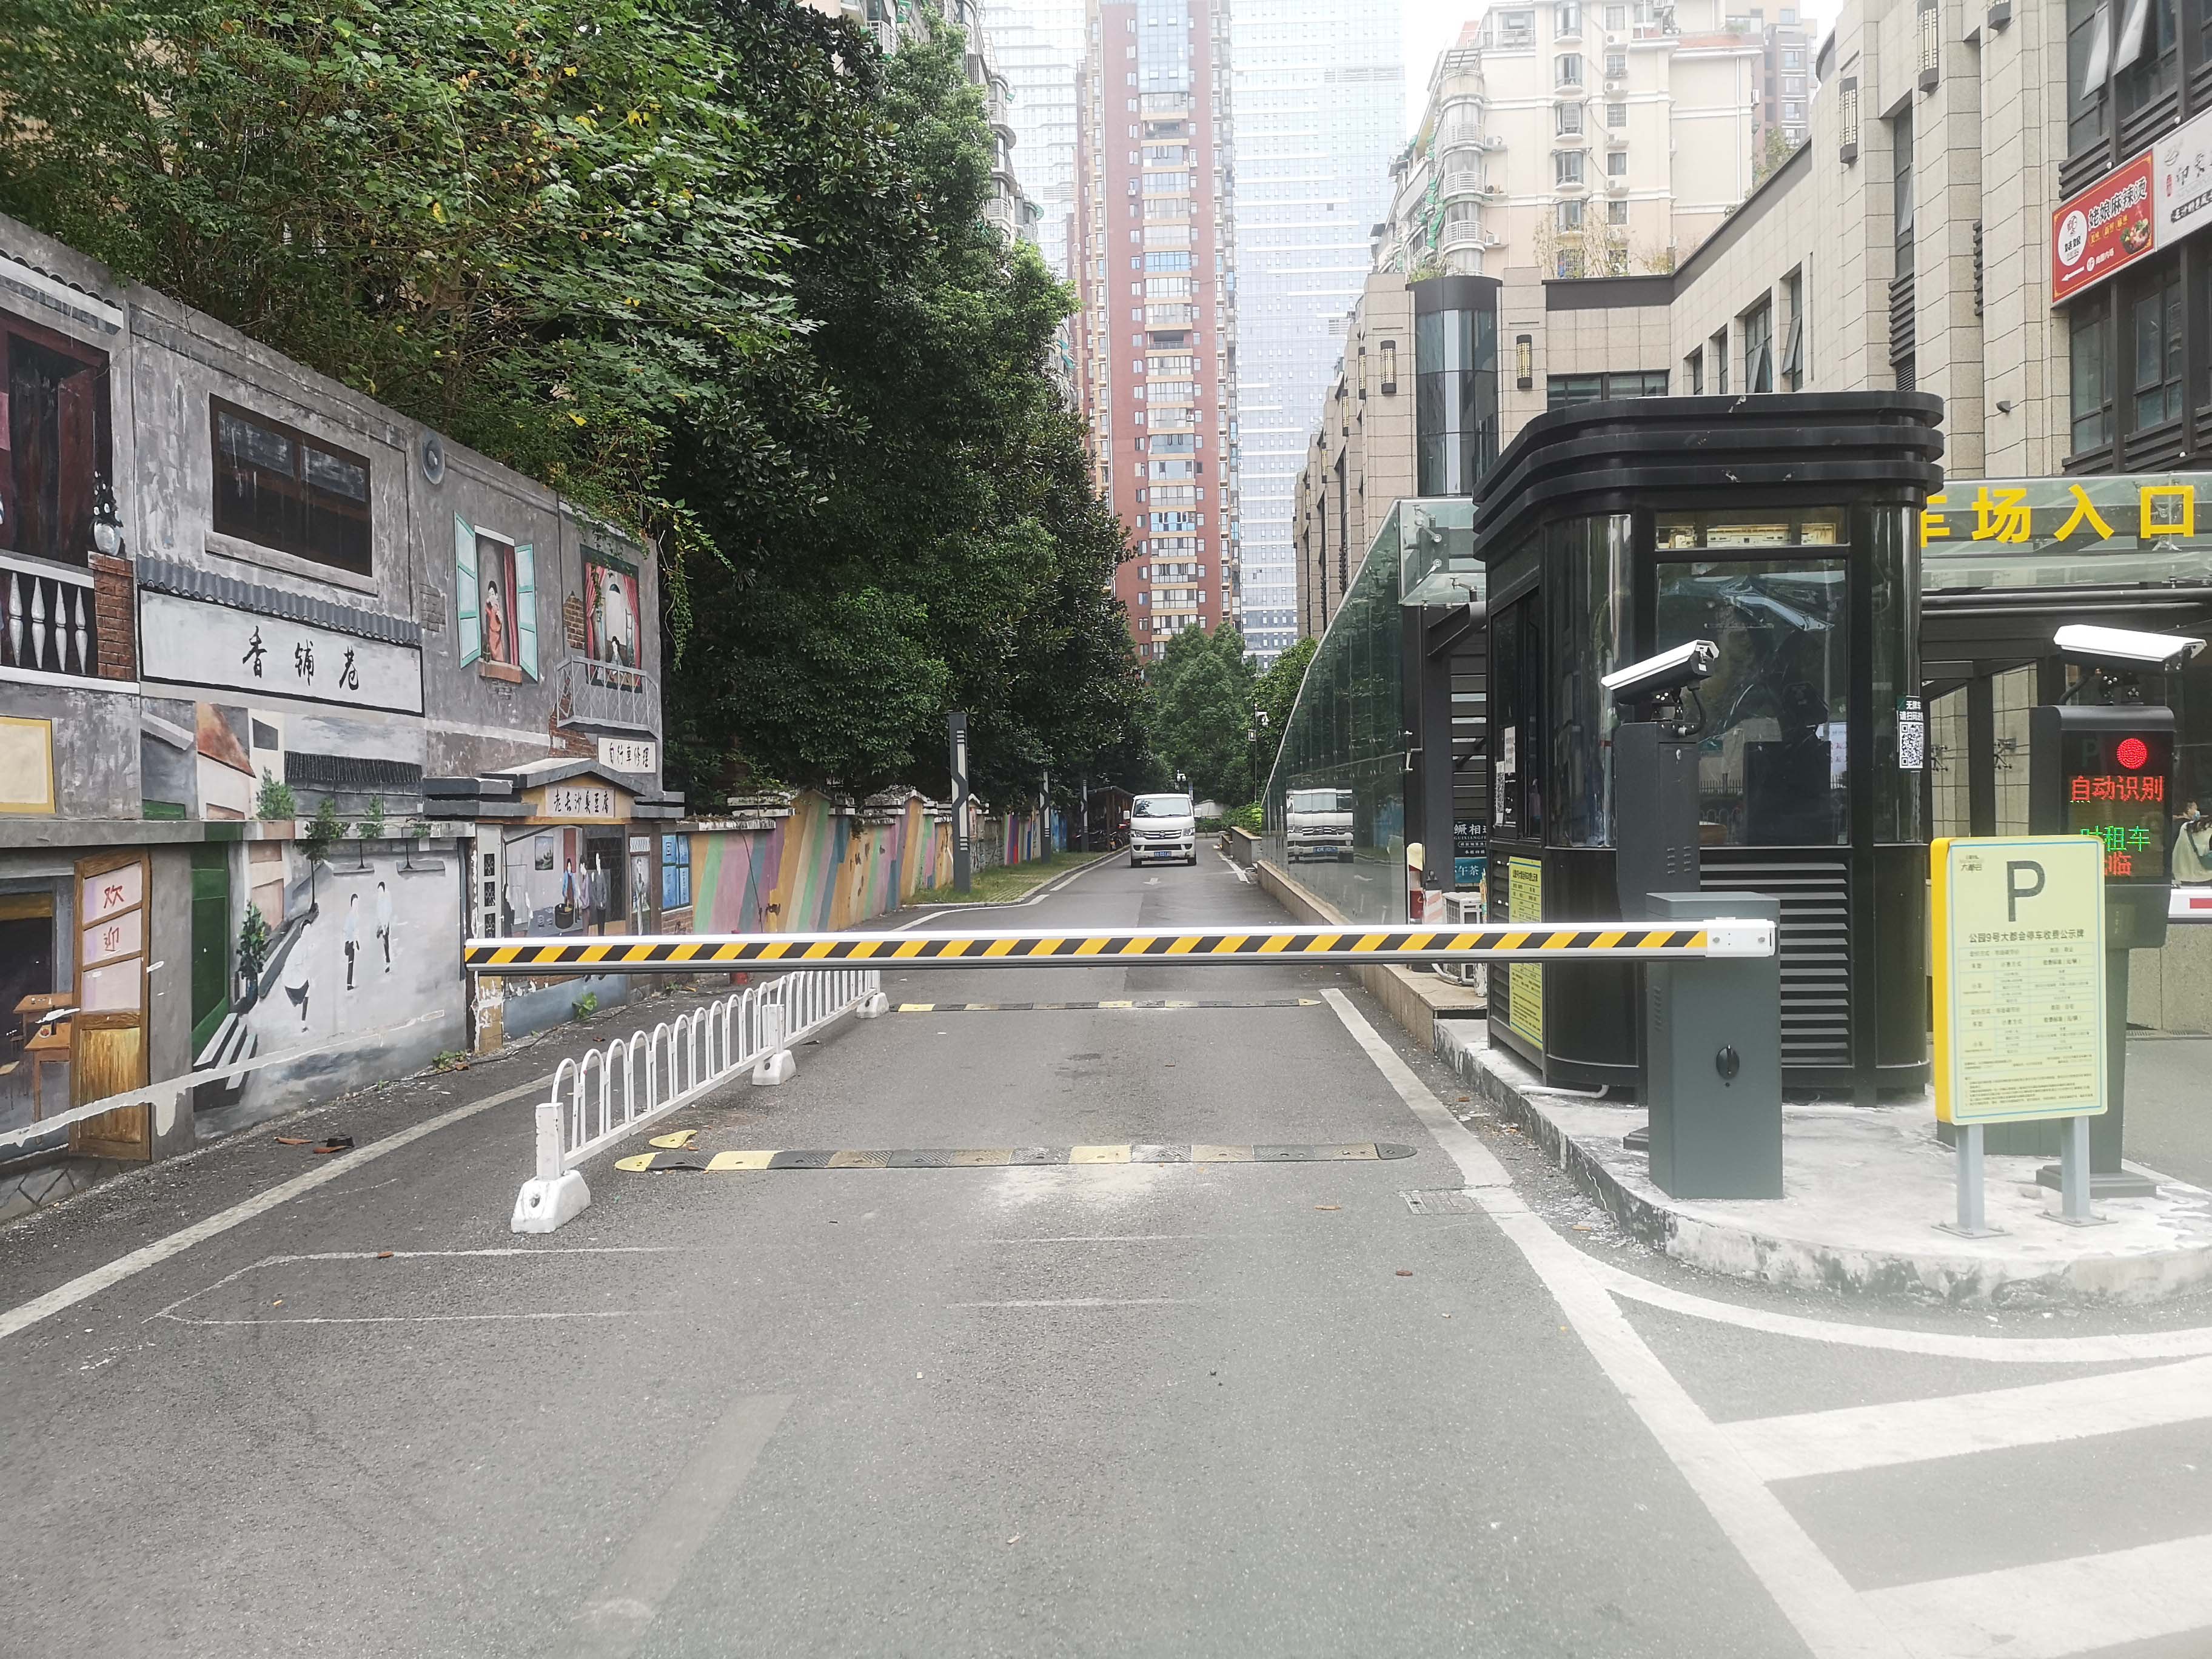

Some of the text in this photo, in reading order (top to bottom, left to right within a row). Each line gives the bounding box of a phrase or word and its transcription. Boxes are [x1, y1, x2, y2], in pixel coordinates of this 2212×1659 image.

[2088, 176, 2147, 229] 姥娘麻辣烫
[2071, 776, 2164, 802] 自动识别
[2006, 860, 2045, 922] P
[1969, 928, 2084, 943] 公园9号大都会停车收费公示牌
